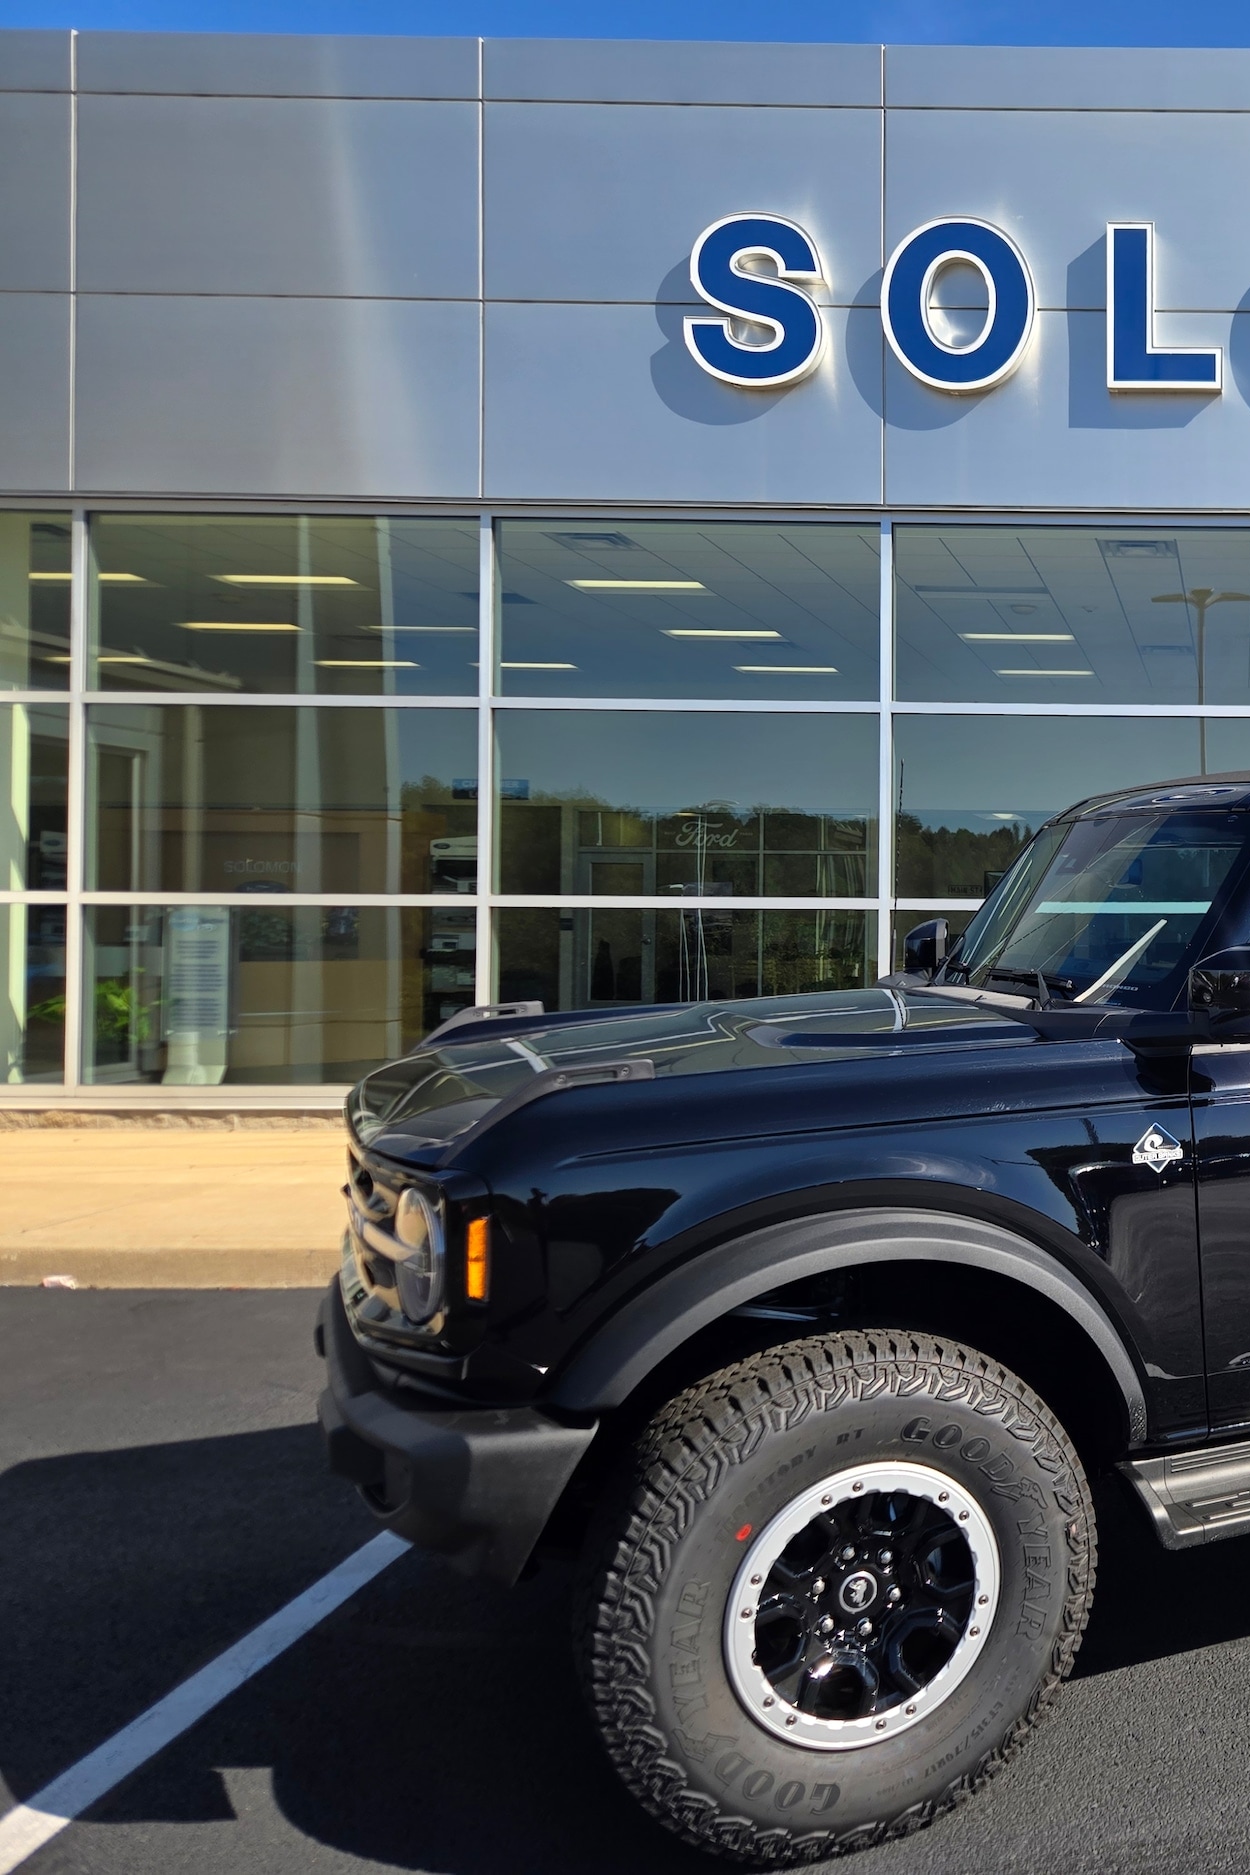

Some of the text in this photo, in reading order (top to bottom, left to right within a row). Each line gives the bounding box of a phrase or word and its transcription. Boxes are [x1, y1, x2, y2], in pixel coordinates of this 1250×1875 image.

[675, 821, 739, 847] Ford
[223, 860, 300, 873] SOLOMON
[835, 1427, 866, 1447] RT
[901, 1415, 1053, 1642] GOODYEAR
[669, 1580, 841, 1816] GOODYEAR
